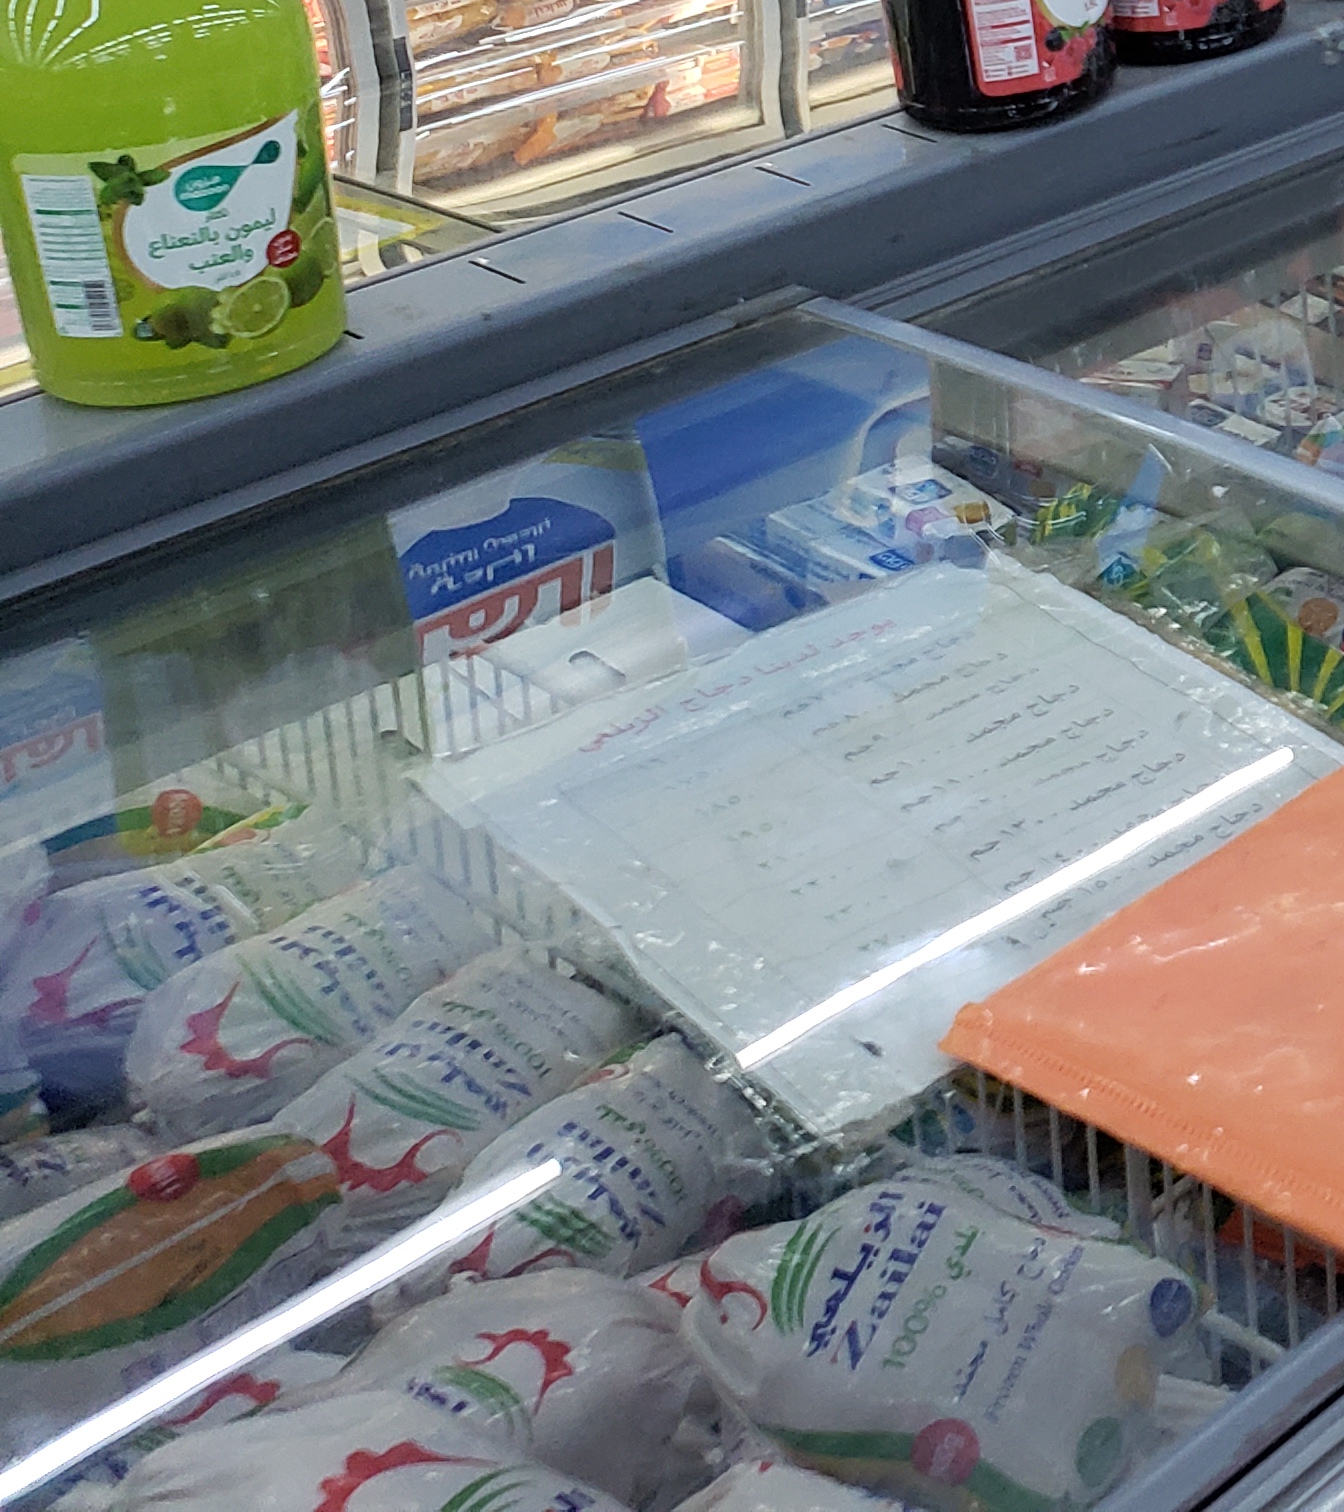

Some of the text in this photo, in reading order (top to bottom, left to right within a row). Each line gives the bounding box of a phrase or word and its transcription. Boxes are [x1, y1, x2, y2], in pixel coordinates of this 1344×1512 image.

[149, 207, 277, 258] ليمون بالنعناع
[189, 244, 254, 272] والعنب
[831, 618, 897, 648] يوجد
[754, 644, 820, 675] لدينا
[680, 675, 752, 713] دجاج
[967, 685, 1080, 743] دجاج مجمد
[1061, 708, 1114, 740] دجاج
[1132, 752, 1187, 786] دجاج
[1070, 782, 1126, 811] مجمد
[1148, 803, 1262, 868] دجاج مجمد
[807, 1191, 903, 1358] الزيلعي
[846, 1201, 947, 1370] Zailai
[883, 1225, 981, 1369] 100% بلدي
[1017, 1302, 1052, 1351] Whole
